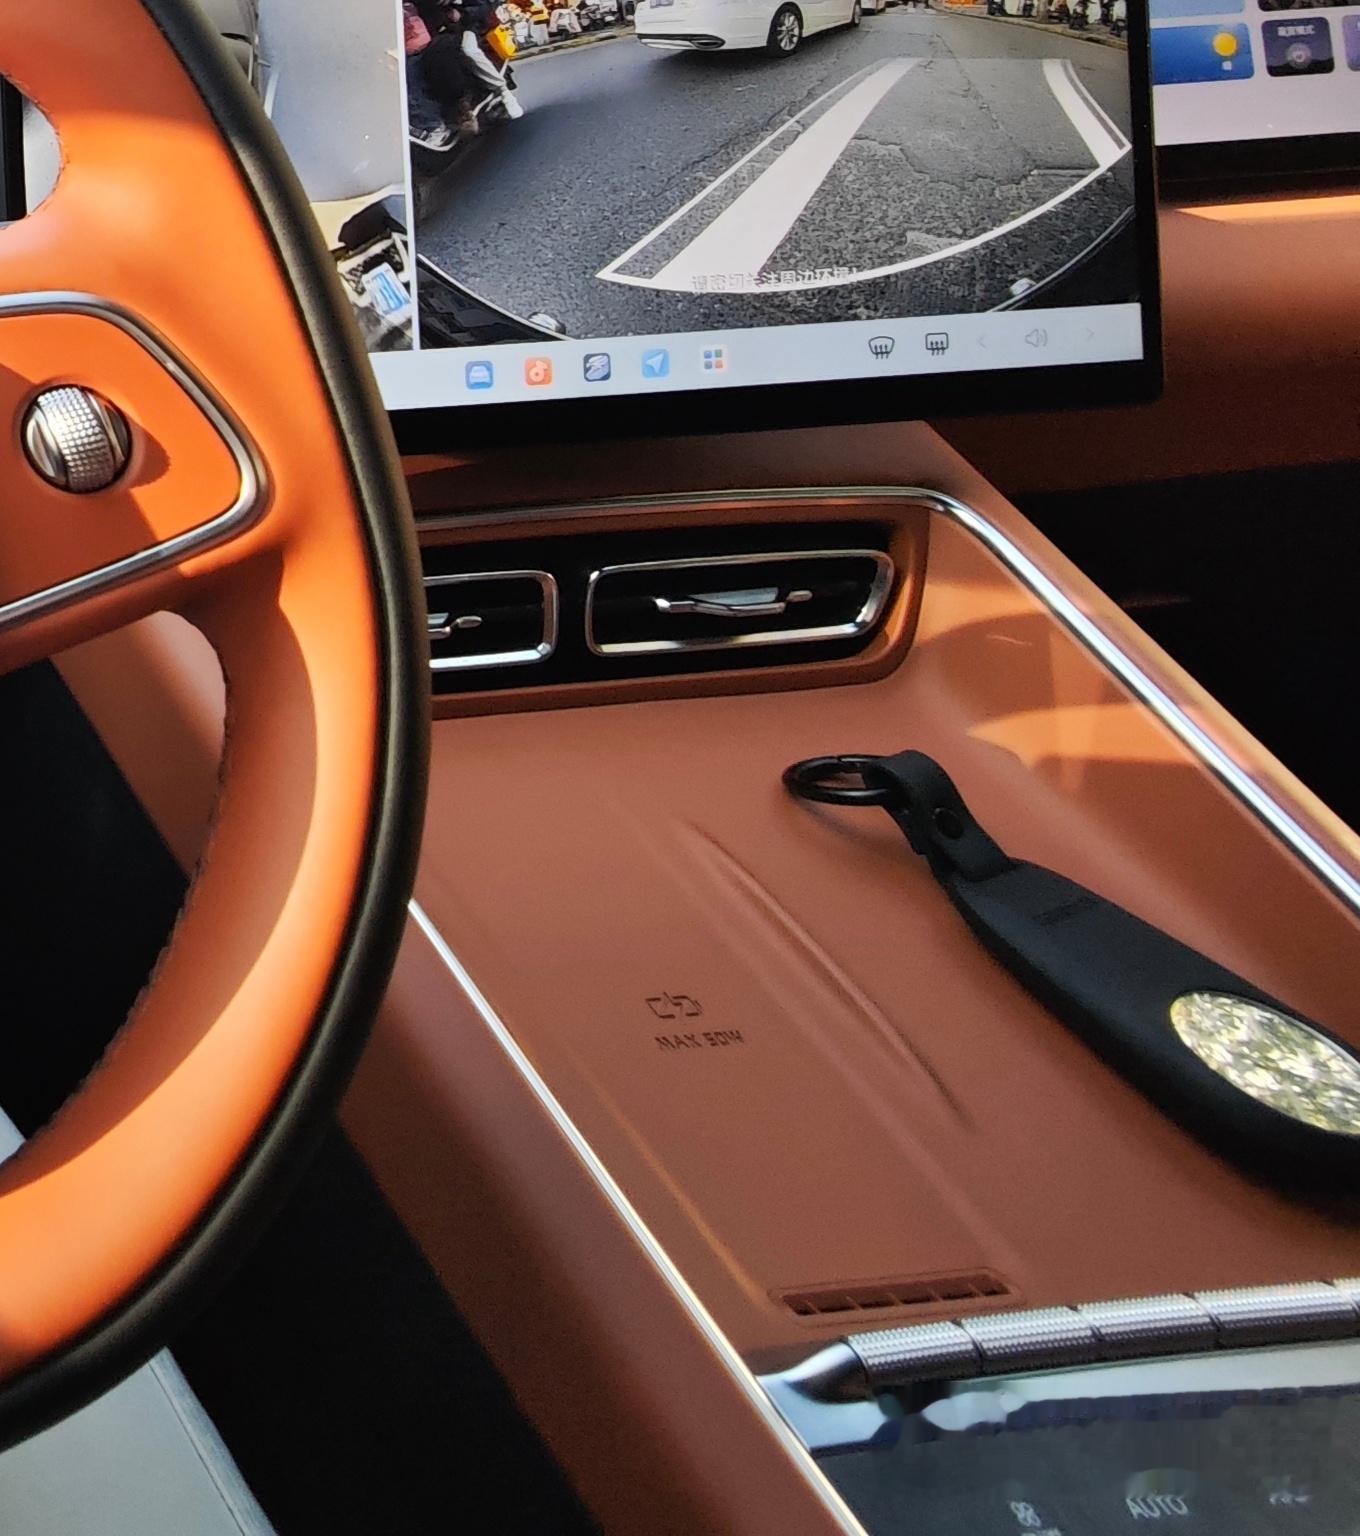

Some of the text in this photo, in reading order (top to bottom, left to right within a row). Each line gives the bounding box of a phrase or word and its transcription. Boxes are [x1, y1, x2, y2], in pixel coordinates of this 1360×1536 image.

[654, 1029, 745, 1051] MAX 50W
[1126, 1494, 1188, 1519] AUTO
